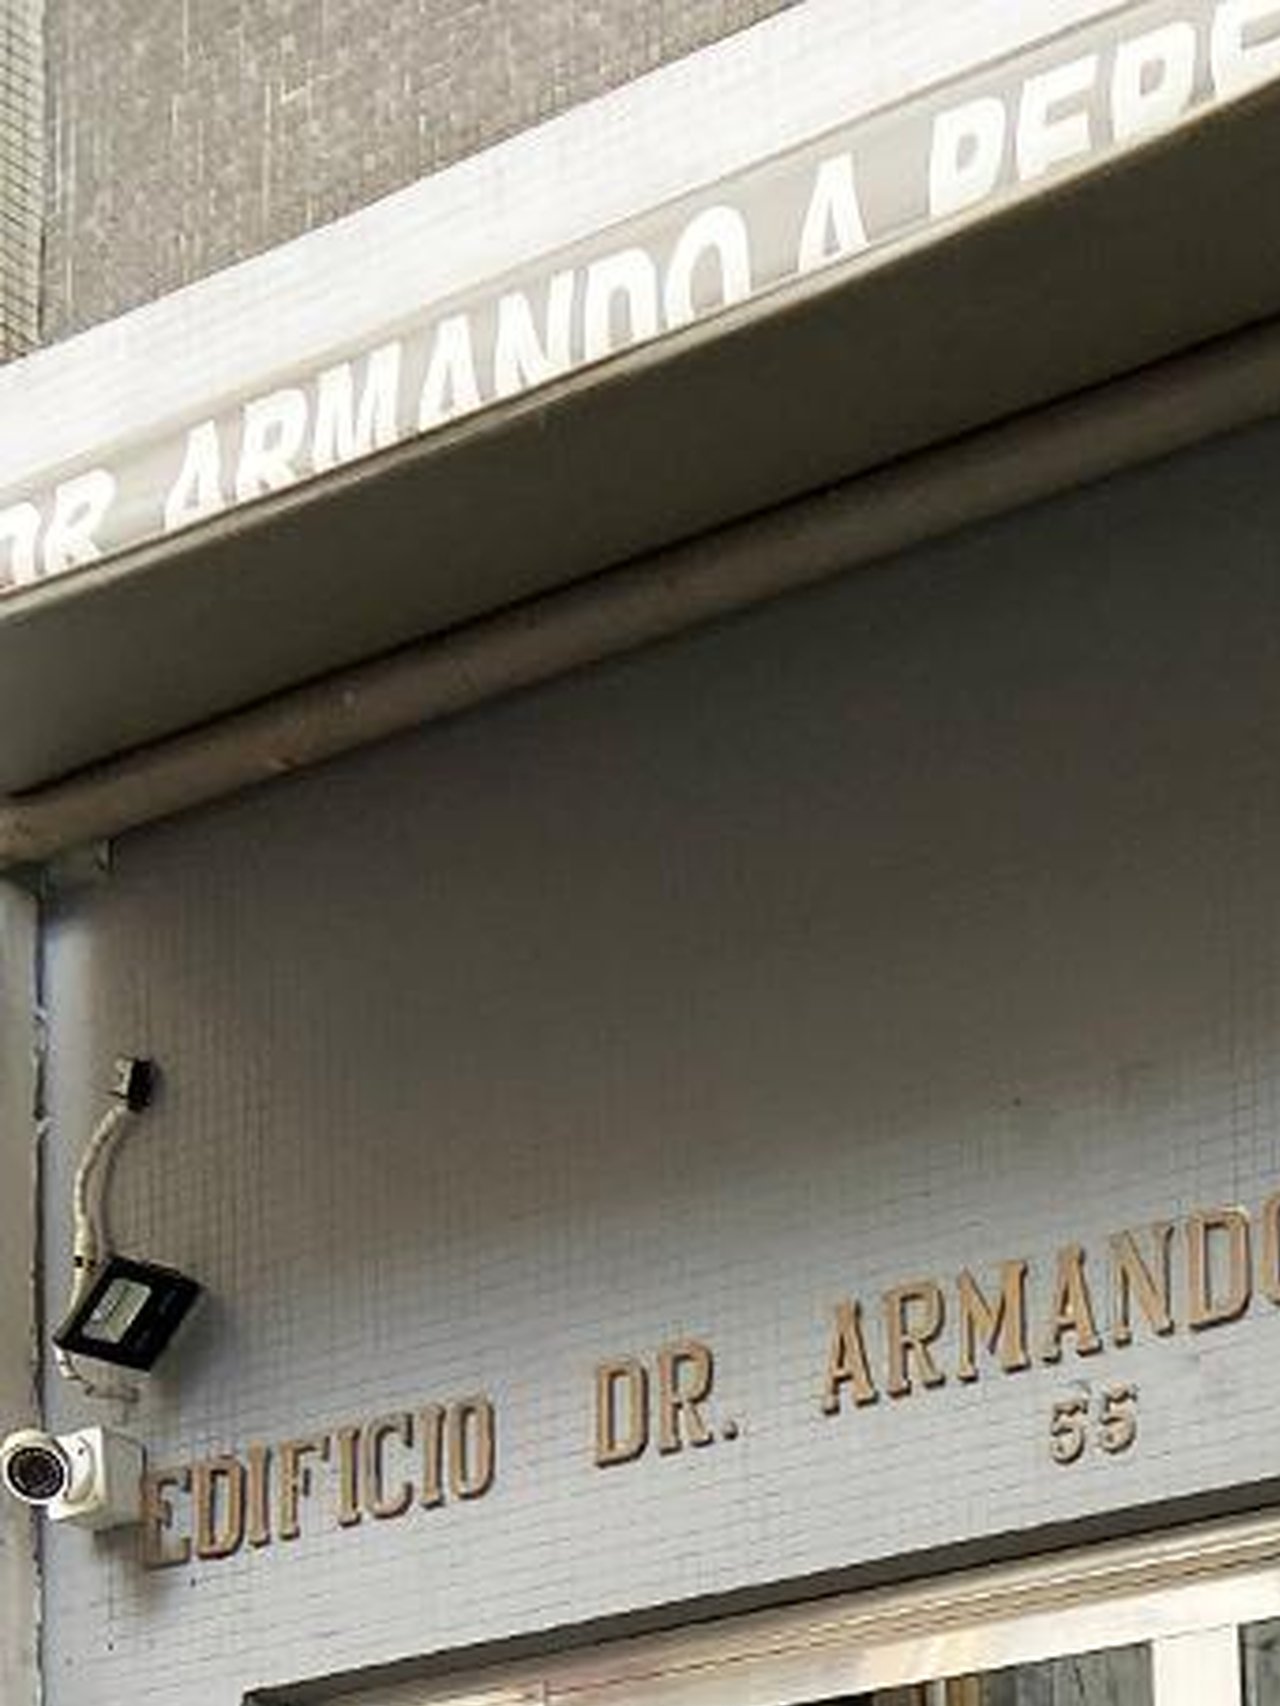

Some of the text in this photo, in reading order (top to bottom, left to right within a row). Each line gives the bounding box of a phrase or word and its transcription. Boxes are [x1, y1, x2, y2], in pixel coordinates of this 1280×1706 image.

[163, 204, 753, 534] ARMANDO
[798, 152, 870, 273] A
[141, 1394, 497, 1570] EDIFICIO
[591, 1337, 740, 1469] DR.
[1049, 1383, 1138, 1465] 55
